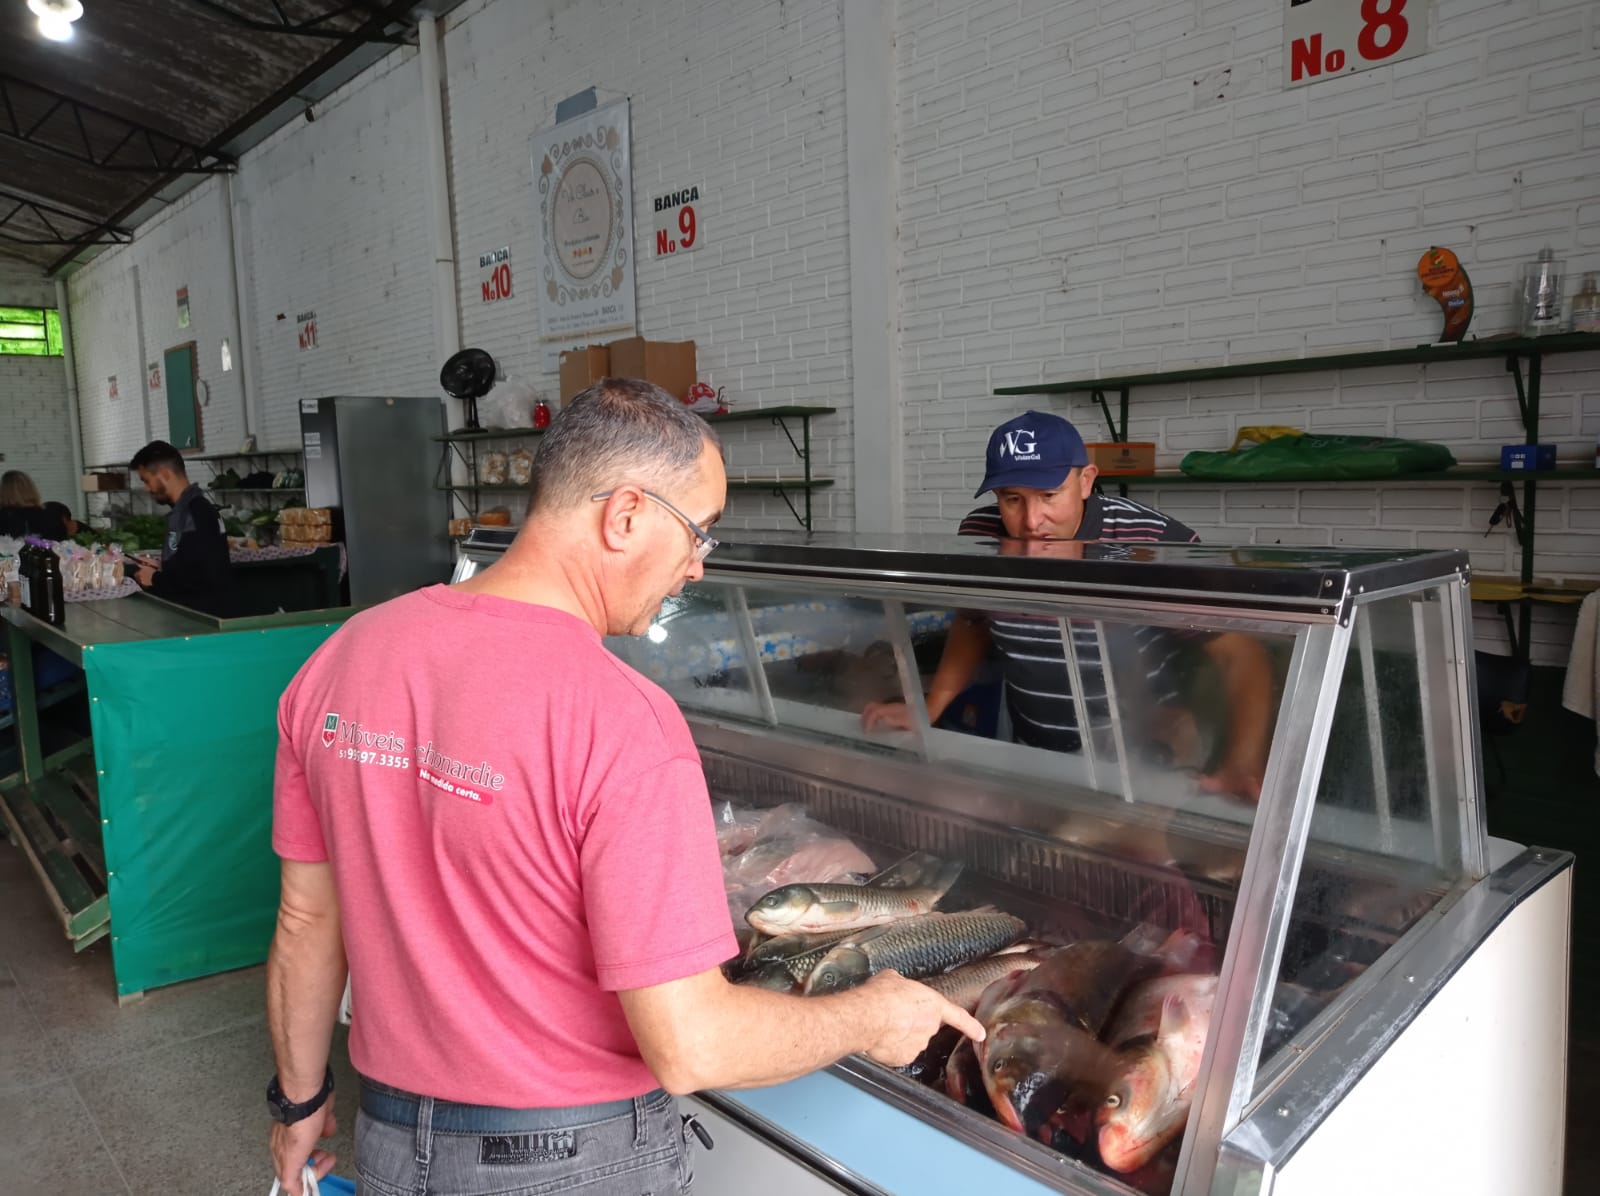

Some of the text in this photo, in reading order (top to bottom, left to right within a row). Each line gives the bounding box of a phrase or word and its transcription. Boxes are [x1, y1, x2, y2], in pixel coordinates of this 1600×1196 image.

[1357, 0, 1409, 60] 8
[654, 186, 700, 212] BANCA
[678, 205, 697, 249] 9
[479, 249, 509, 268] BANCA
[491, 263, 511, 300] 10
[999, 429, 1037, 458] WG
[338, 720, 505, 792] Móveis chonardie
[455, 786, 482, 802] certa.
